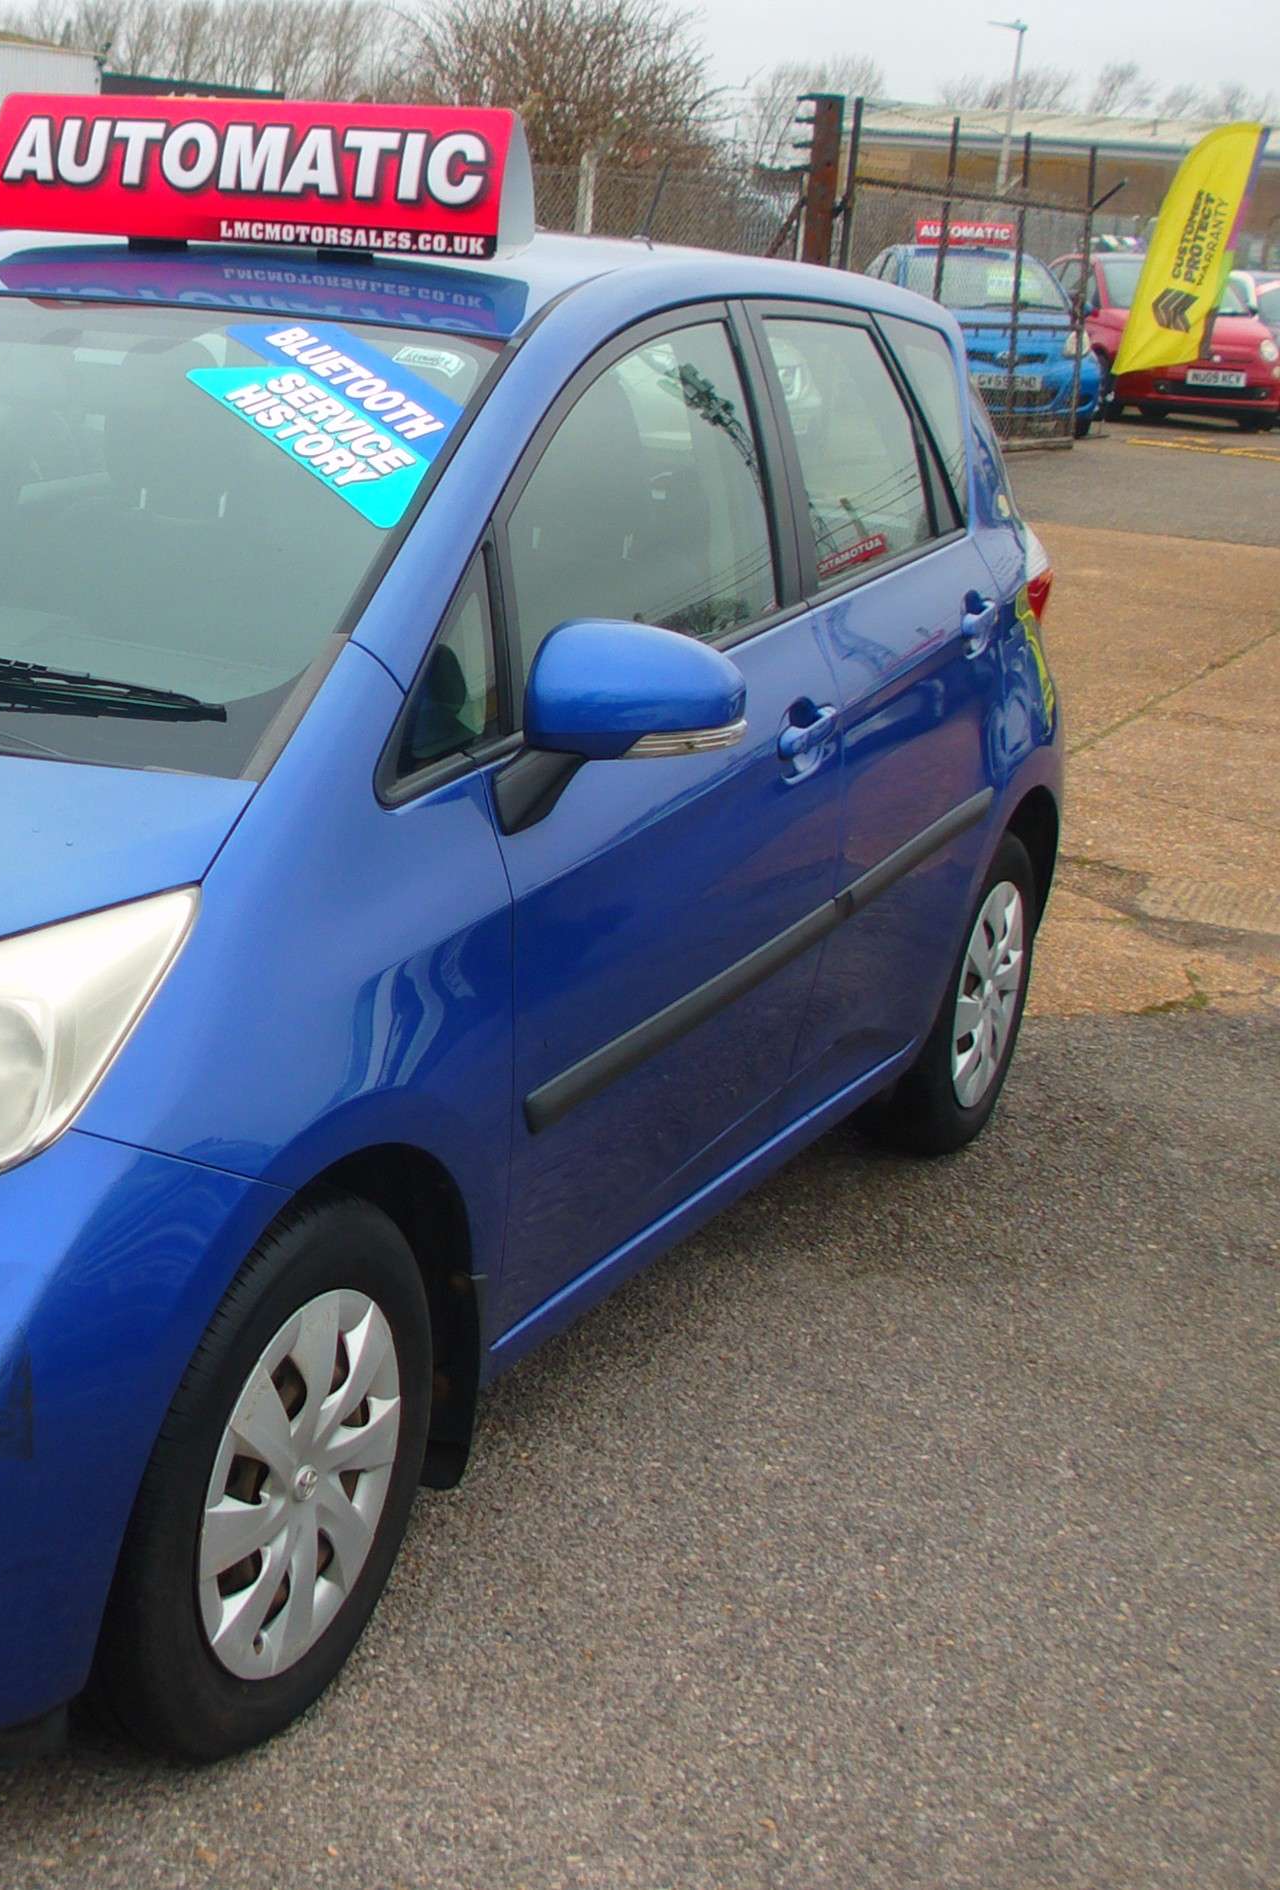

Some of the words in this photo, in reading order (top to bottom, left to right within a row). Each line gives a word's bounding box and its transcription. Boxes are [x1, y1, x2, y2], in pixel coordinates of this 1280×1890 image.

[2, 116, 487, 206] AUTOMATIC
[220, 219, 486, 256] LMCMOTORSALES.CO.UK
[920, 224, 1010, 239] AUOMATIC
[1172, 188, 1205, 280] CUSTOMER
[1184, 191, 1216, 284] PROTECT
[1197, 198, 1229, 287] WARRANTY
[265, 326, 445, 440] BLUETOOTH
[266, 372, 416, 475] SERVICE
[224, 383, 380, 486] HISTORY
